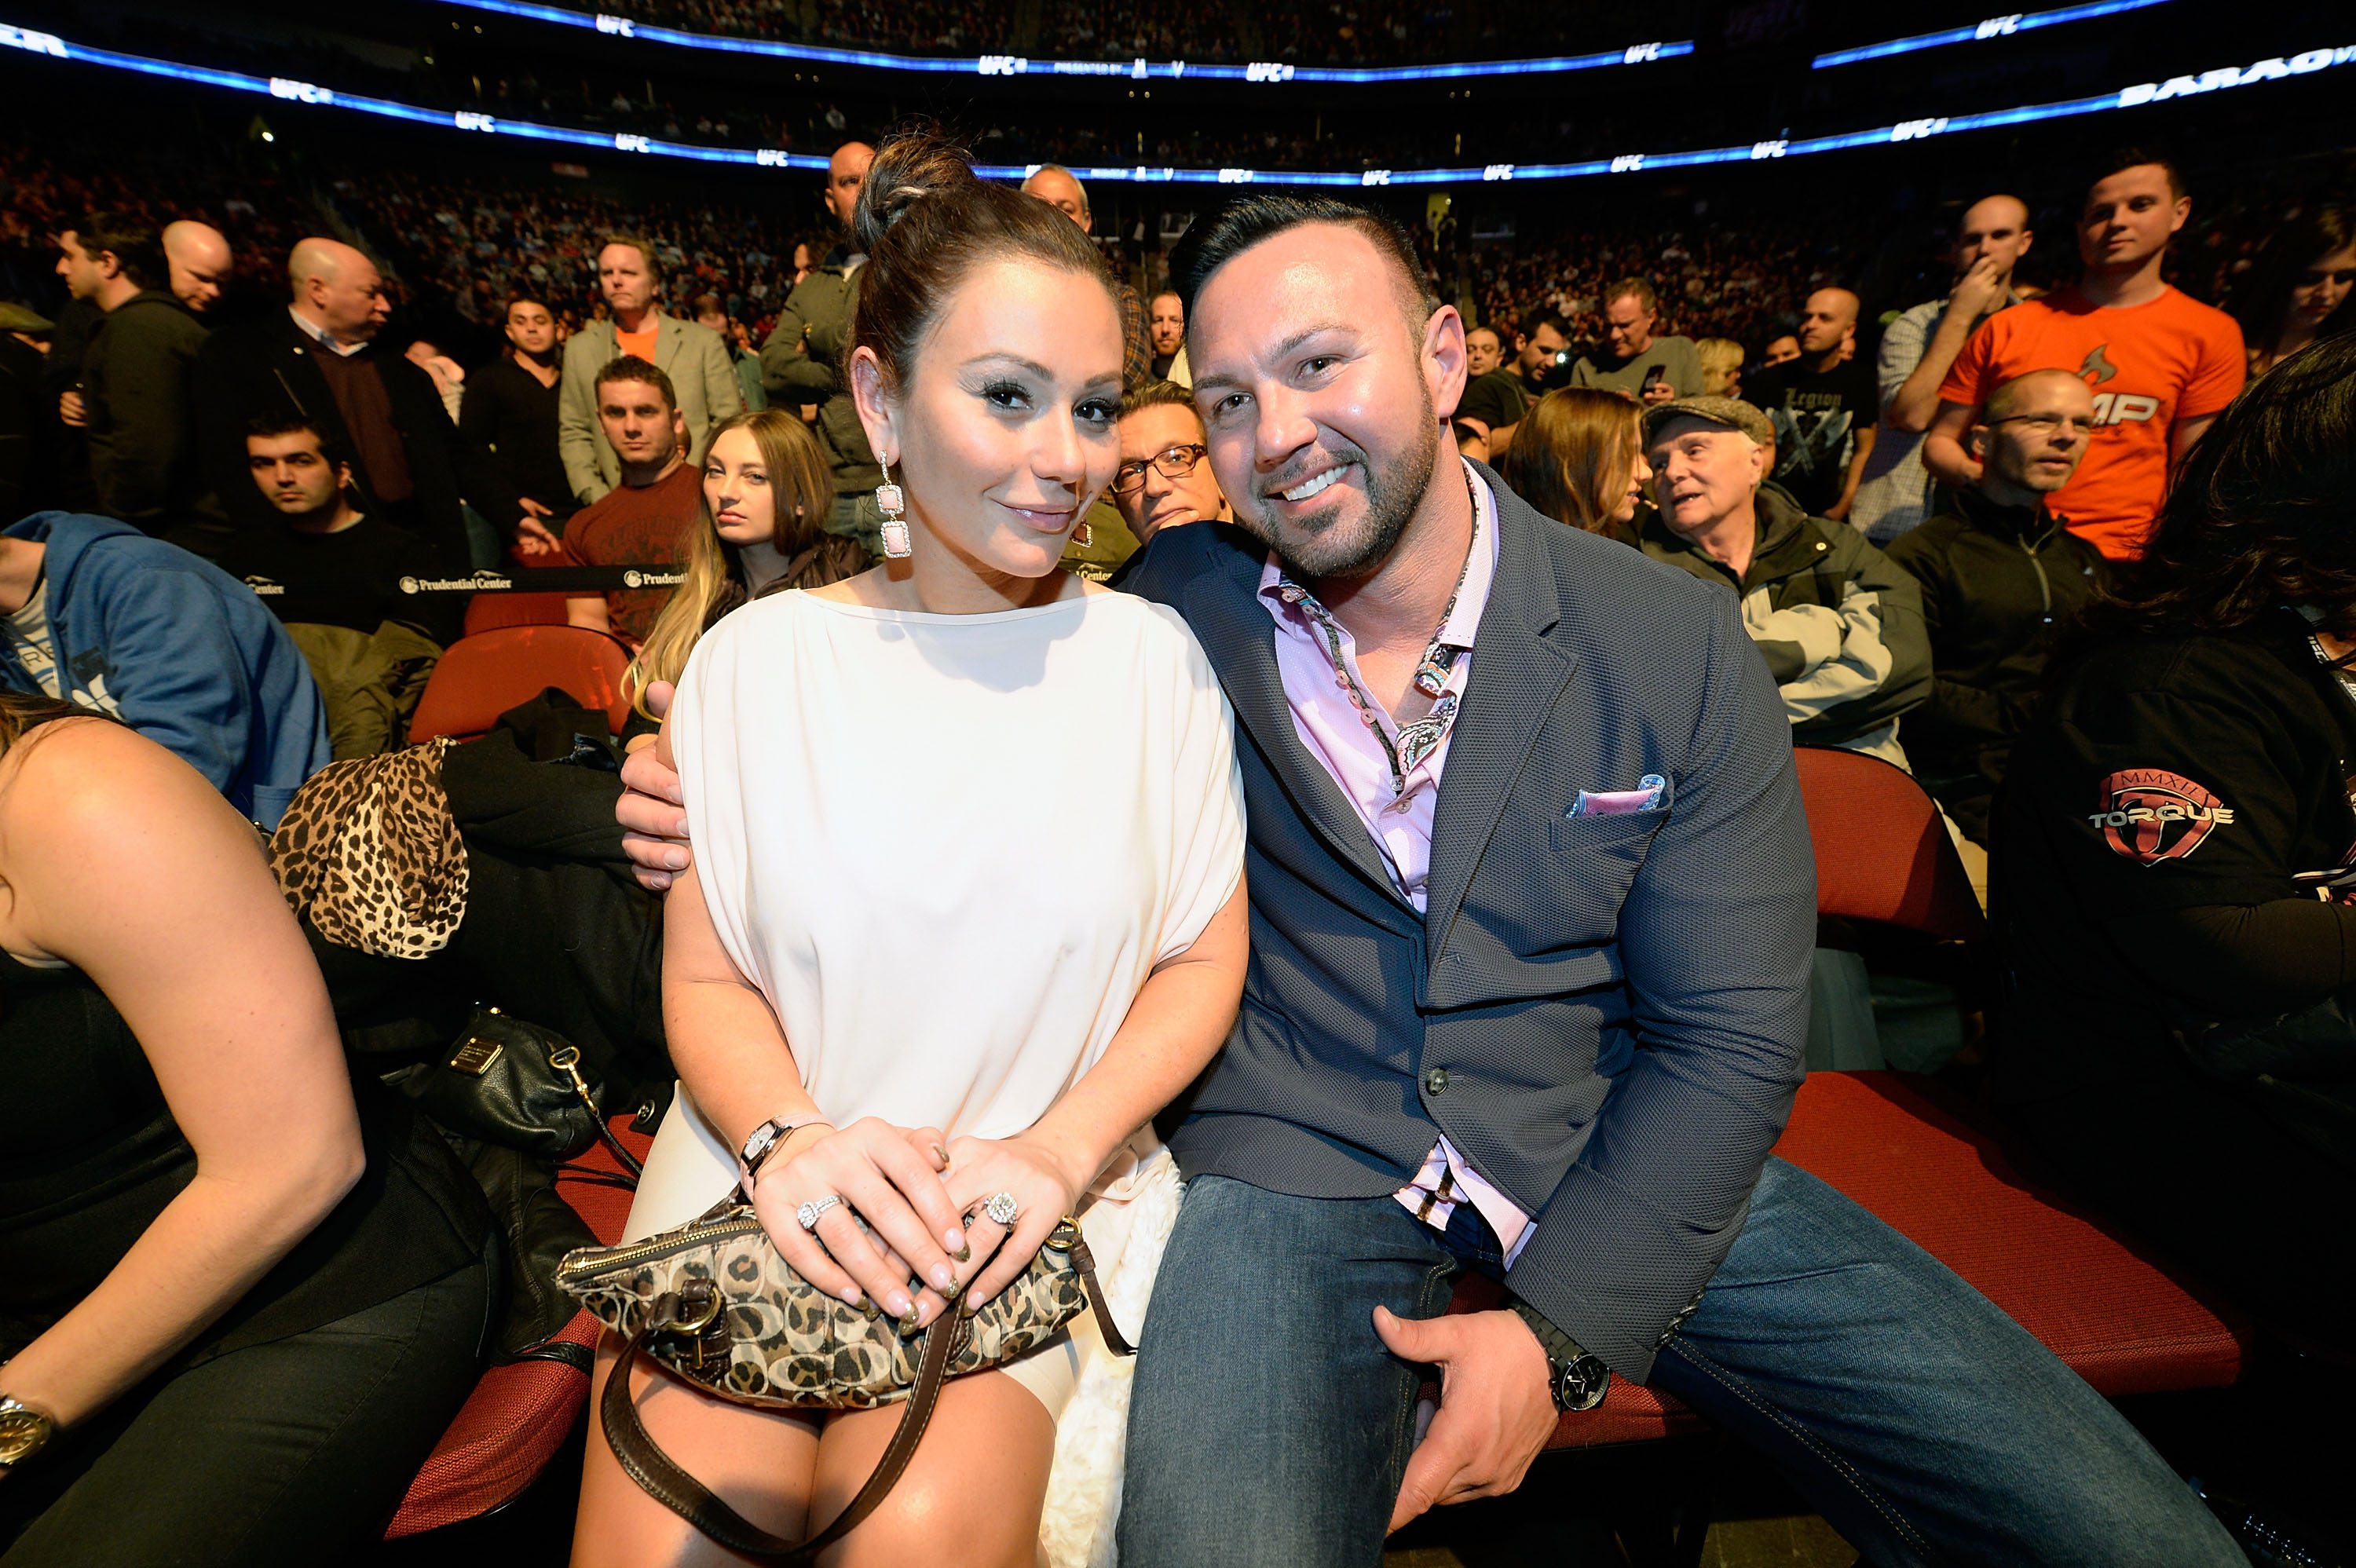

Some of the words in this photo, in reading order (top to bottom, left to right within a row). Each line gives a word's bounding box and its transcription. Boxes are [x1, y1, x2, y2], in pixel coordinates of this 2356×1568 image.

[596, 13, 635, 38] UFC
[1975, 13, 2023, 40] UFC
[1624, 42, 1662, 64] UFC
[979, 55, 1015, 75] UFC
[1246, 62, 1282, 82] UFC
[2117, 48, 2333, 108] BARAO
[270, 77, 318, 104] UFC
[455, 110, 495, 133] UFC
[1890, 118, 1936, 142] UFC
[616, 133, 650, 153] UFC
[1751, 140, 1789, 160] UFC
[756, 148, 788, 167] UFC
[1611, 154, 1644, 173] UFC
[1218, 168, 1244, 183] UFC
[1362, 170, 1392, 185] UFC
[1483, 164, 1514, 181] UFC
[419, 578, 477, 591] Prudential
[477, 577, 512, 589] Center
[642, 572, 689, 585] Prudenti
[2121, 772, 2198, 795] MMXII
[2088, 805, 2235, 828] TORQUE
